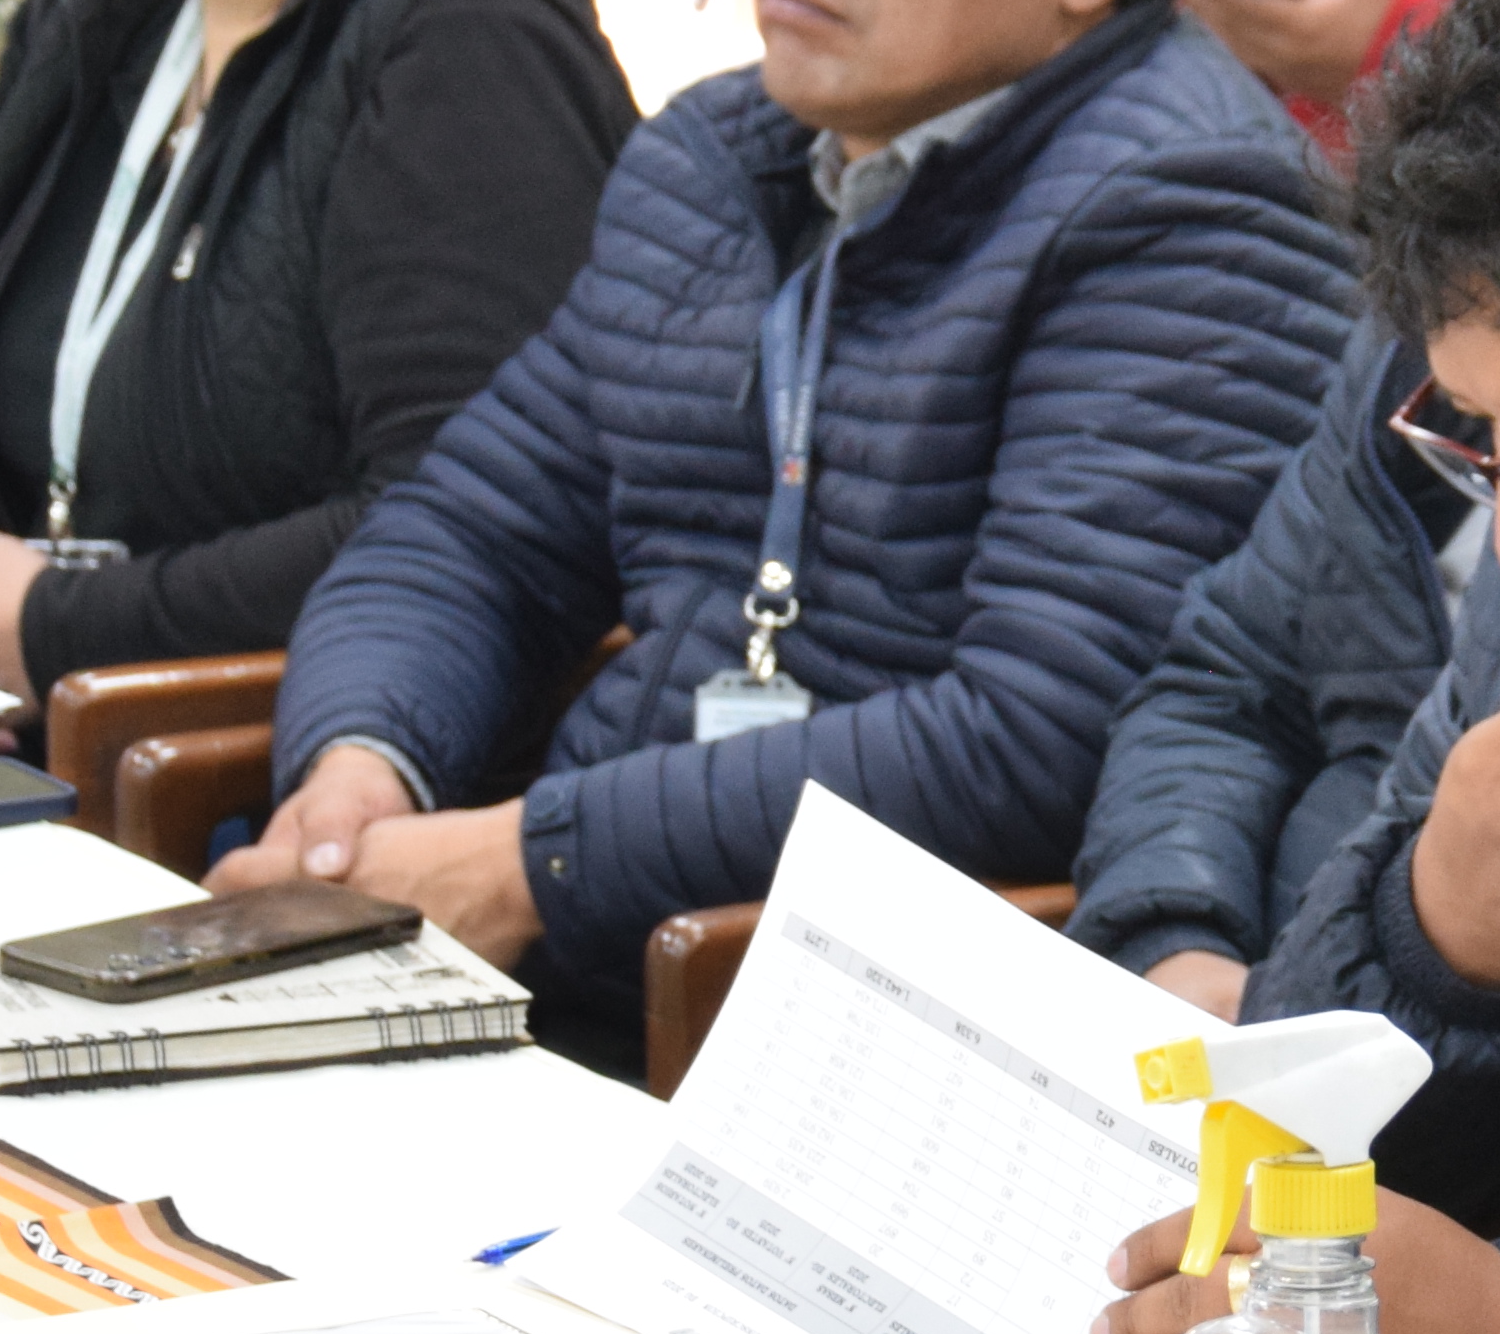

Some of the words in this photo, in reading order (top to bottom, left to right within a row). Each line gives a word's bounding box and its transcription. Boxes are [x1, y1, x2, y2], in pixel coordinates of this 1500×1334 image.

[803, 929, 832, 954] 1.275
[800, 955, 817, 971] 132
[793, 977, 808, 993] 176
[864, 965, 912, 1004] 1.442.320
[783, 998, 800, 1015] 128
[773, 1019, 791, 1036] 170
[954, 1019, 981, 1047] 6.338
[764, 1041, 781, 1057] 118
[952, 1048, 969, 1066] 747
[754, 1060, 771, 1078] 112
[945, 1071, 963, 1088] 627
[1030, 1069, 1049, 1089] 837
[743, 1082, 761, 1099] 114
[938, 1091, 955, 1110] 545
[1028, 1095, 1039, 1110] 74
[733, 1102, 750, 1118] 166
[1095, 1108, 1115, 1129] 472
[720, 1122, 738, 1139] 142
[930, 1114, 948, 1133] 561
[1019, 1116, 1037, 1134] 150
[921, 1136, 940, 1154] 600
[1016, 1140, 1027, 1155] 98
[1093, 1135, 1105, 1150] 21
[709, 1146, 723, 1157] 17
[1148, 1139, 1199, 1176] OTALES
[911, 1157, 930, 1176] 668
[1005, 1161, 1023, 1179] 145
[1084, 1156, 1100, 1175] 132
[662, 1168, 720, 1208] ELECTORALES
[902, 1180, 919, 1198] 704
[1082, 1181, 1092, 1197] 73
[1156, 1173, 1172, 1188] 28
[1000, 1185, 1014, 1201] 80
[890, 1201, 909, 1219] 969
[1072, 1202, 1090, 1221] 132
[1147, 1197, 1163, 1212] 27
[991, 1208, 1006, 1223] 57
[877, 1223, 899, 1239] 897
[982, 1229, 997, 1245] 55
[1067, 1229, 1081, 1242] 67
[741, 1228, 784, 1259] VOTANTES
[868, 1243, 883, 1258] 20
[972, 1252, 986, 1266] 89
[1061, 1250, 1074, 1265] 20
[740, 1273, 769, 1294] DATOS
[960, 1272, 974, 1288] 72
[768, 1290, 797, 1312] DATOS
[827, 1272, 888, 1314] ELECTORALES
[946, 1293, 961, 1307] 17
[1042, 1295, 1055, 1310] 10
